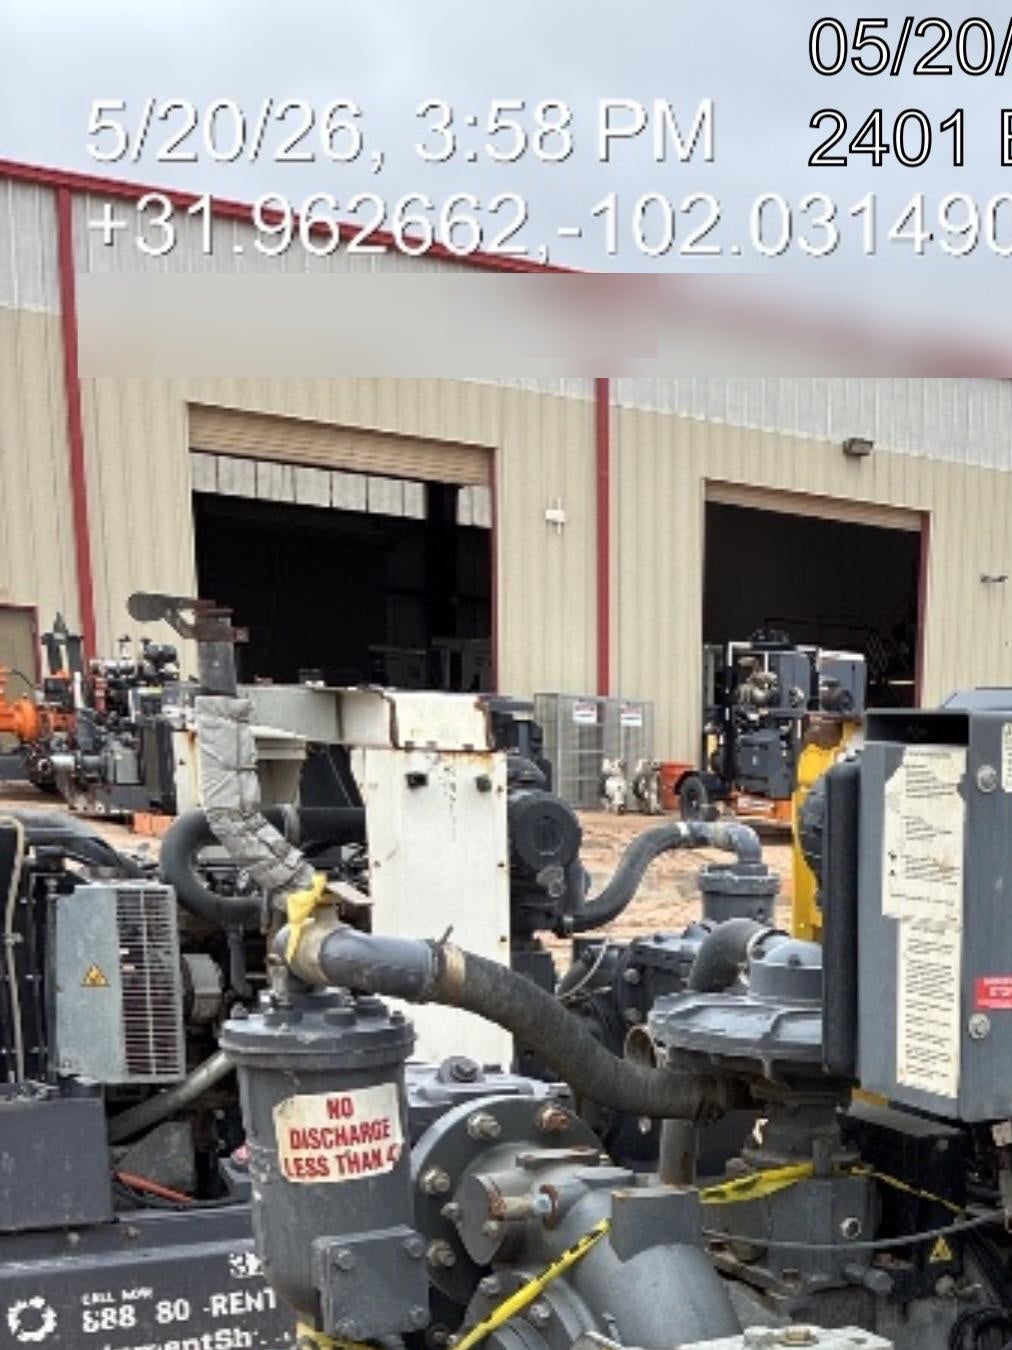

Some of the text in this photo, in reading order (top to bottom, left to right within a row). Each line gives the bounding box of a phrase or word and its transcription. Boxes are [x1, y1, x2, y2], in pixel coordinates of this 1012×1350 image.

[326, 1097, 354, 1119] NO
[289, 1118, 391, 1150] DISCHARGE
[284, 1155, 330, 1177] LESS
[336, 1149, 383, 1175] THAN
